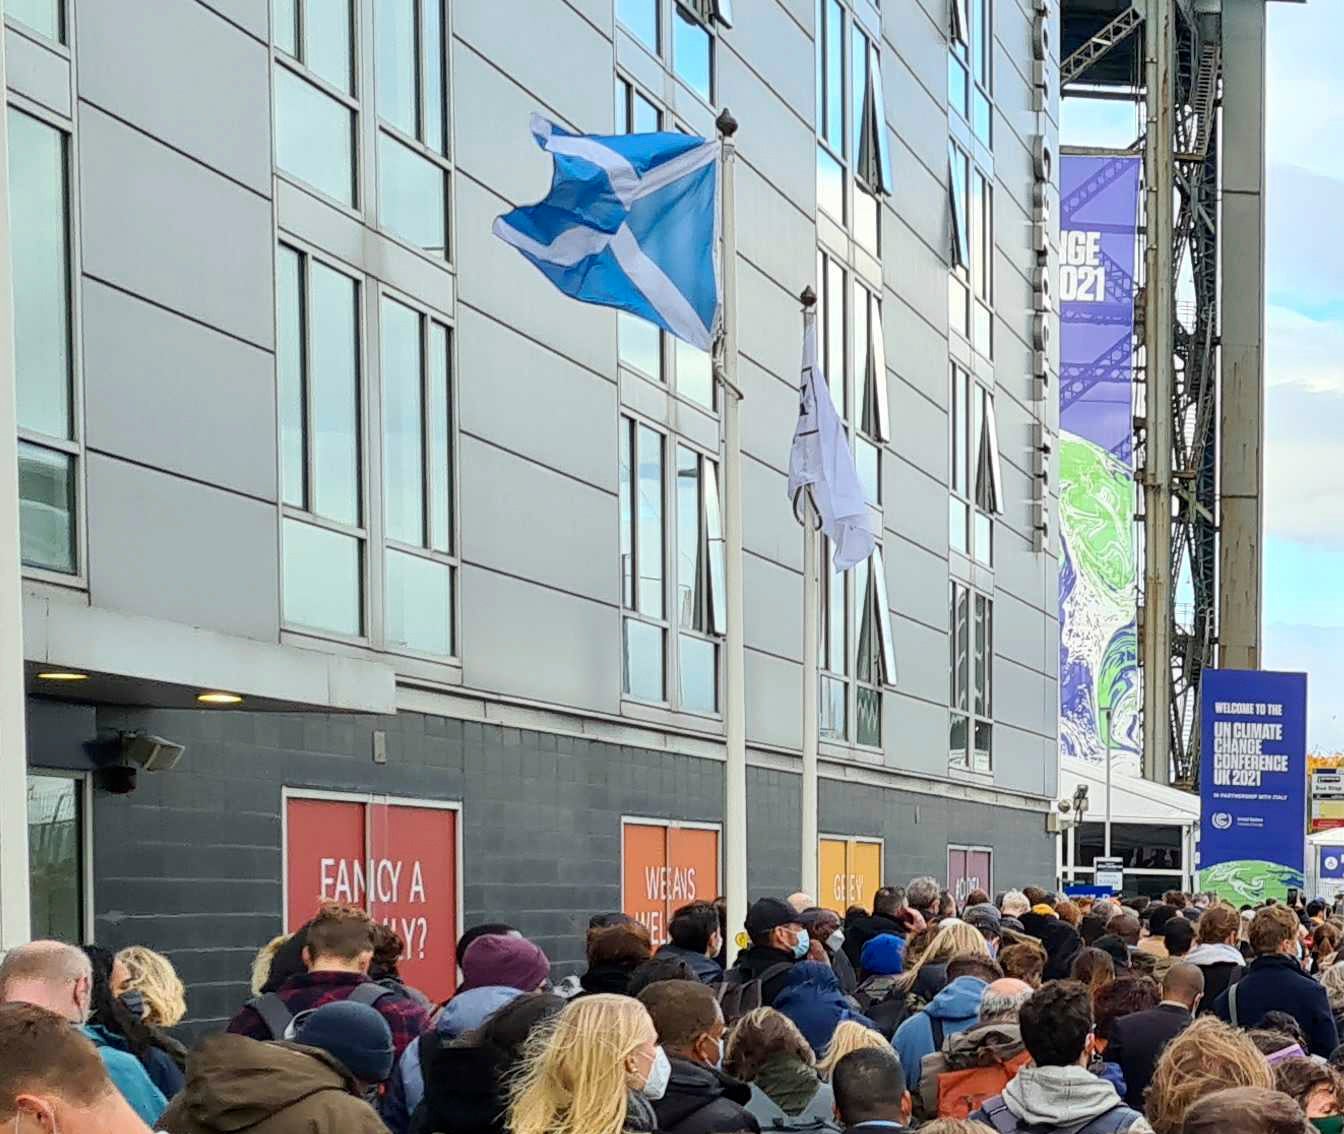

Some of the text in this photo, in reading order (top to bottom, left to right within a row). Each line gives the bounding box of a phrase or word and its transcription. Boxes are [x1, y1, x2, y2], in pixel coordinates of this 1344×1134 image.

[1214, 701, 1283, 716] WELCOME TO THE
[1214, 721, 1283, 740] UN CLIMATE
[1214, 737, 1262, 754] CHANGE
[1214, 753, 1289, 772] CONFERENCE
[1214, 769, 1261, 787] UK 2021
[320, 858, 426, 904] FANCY A
